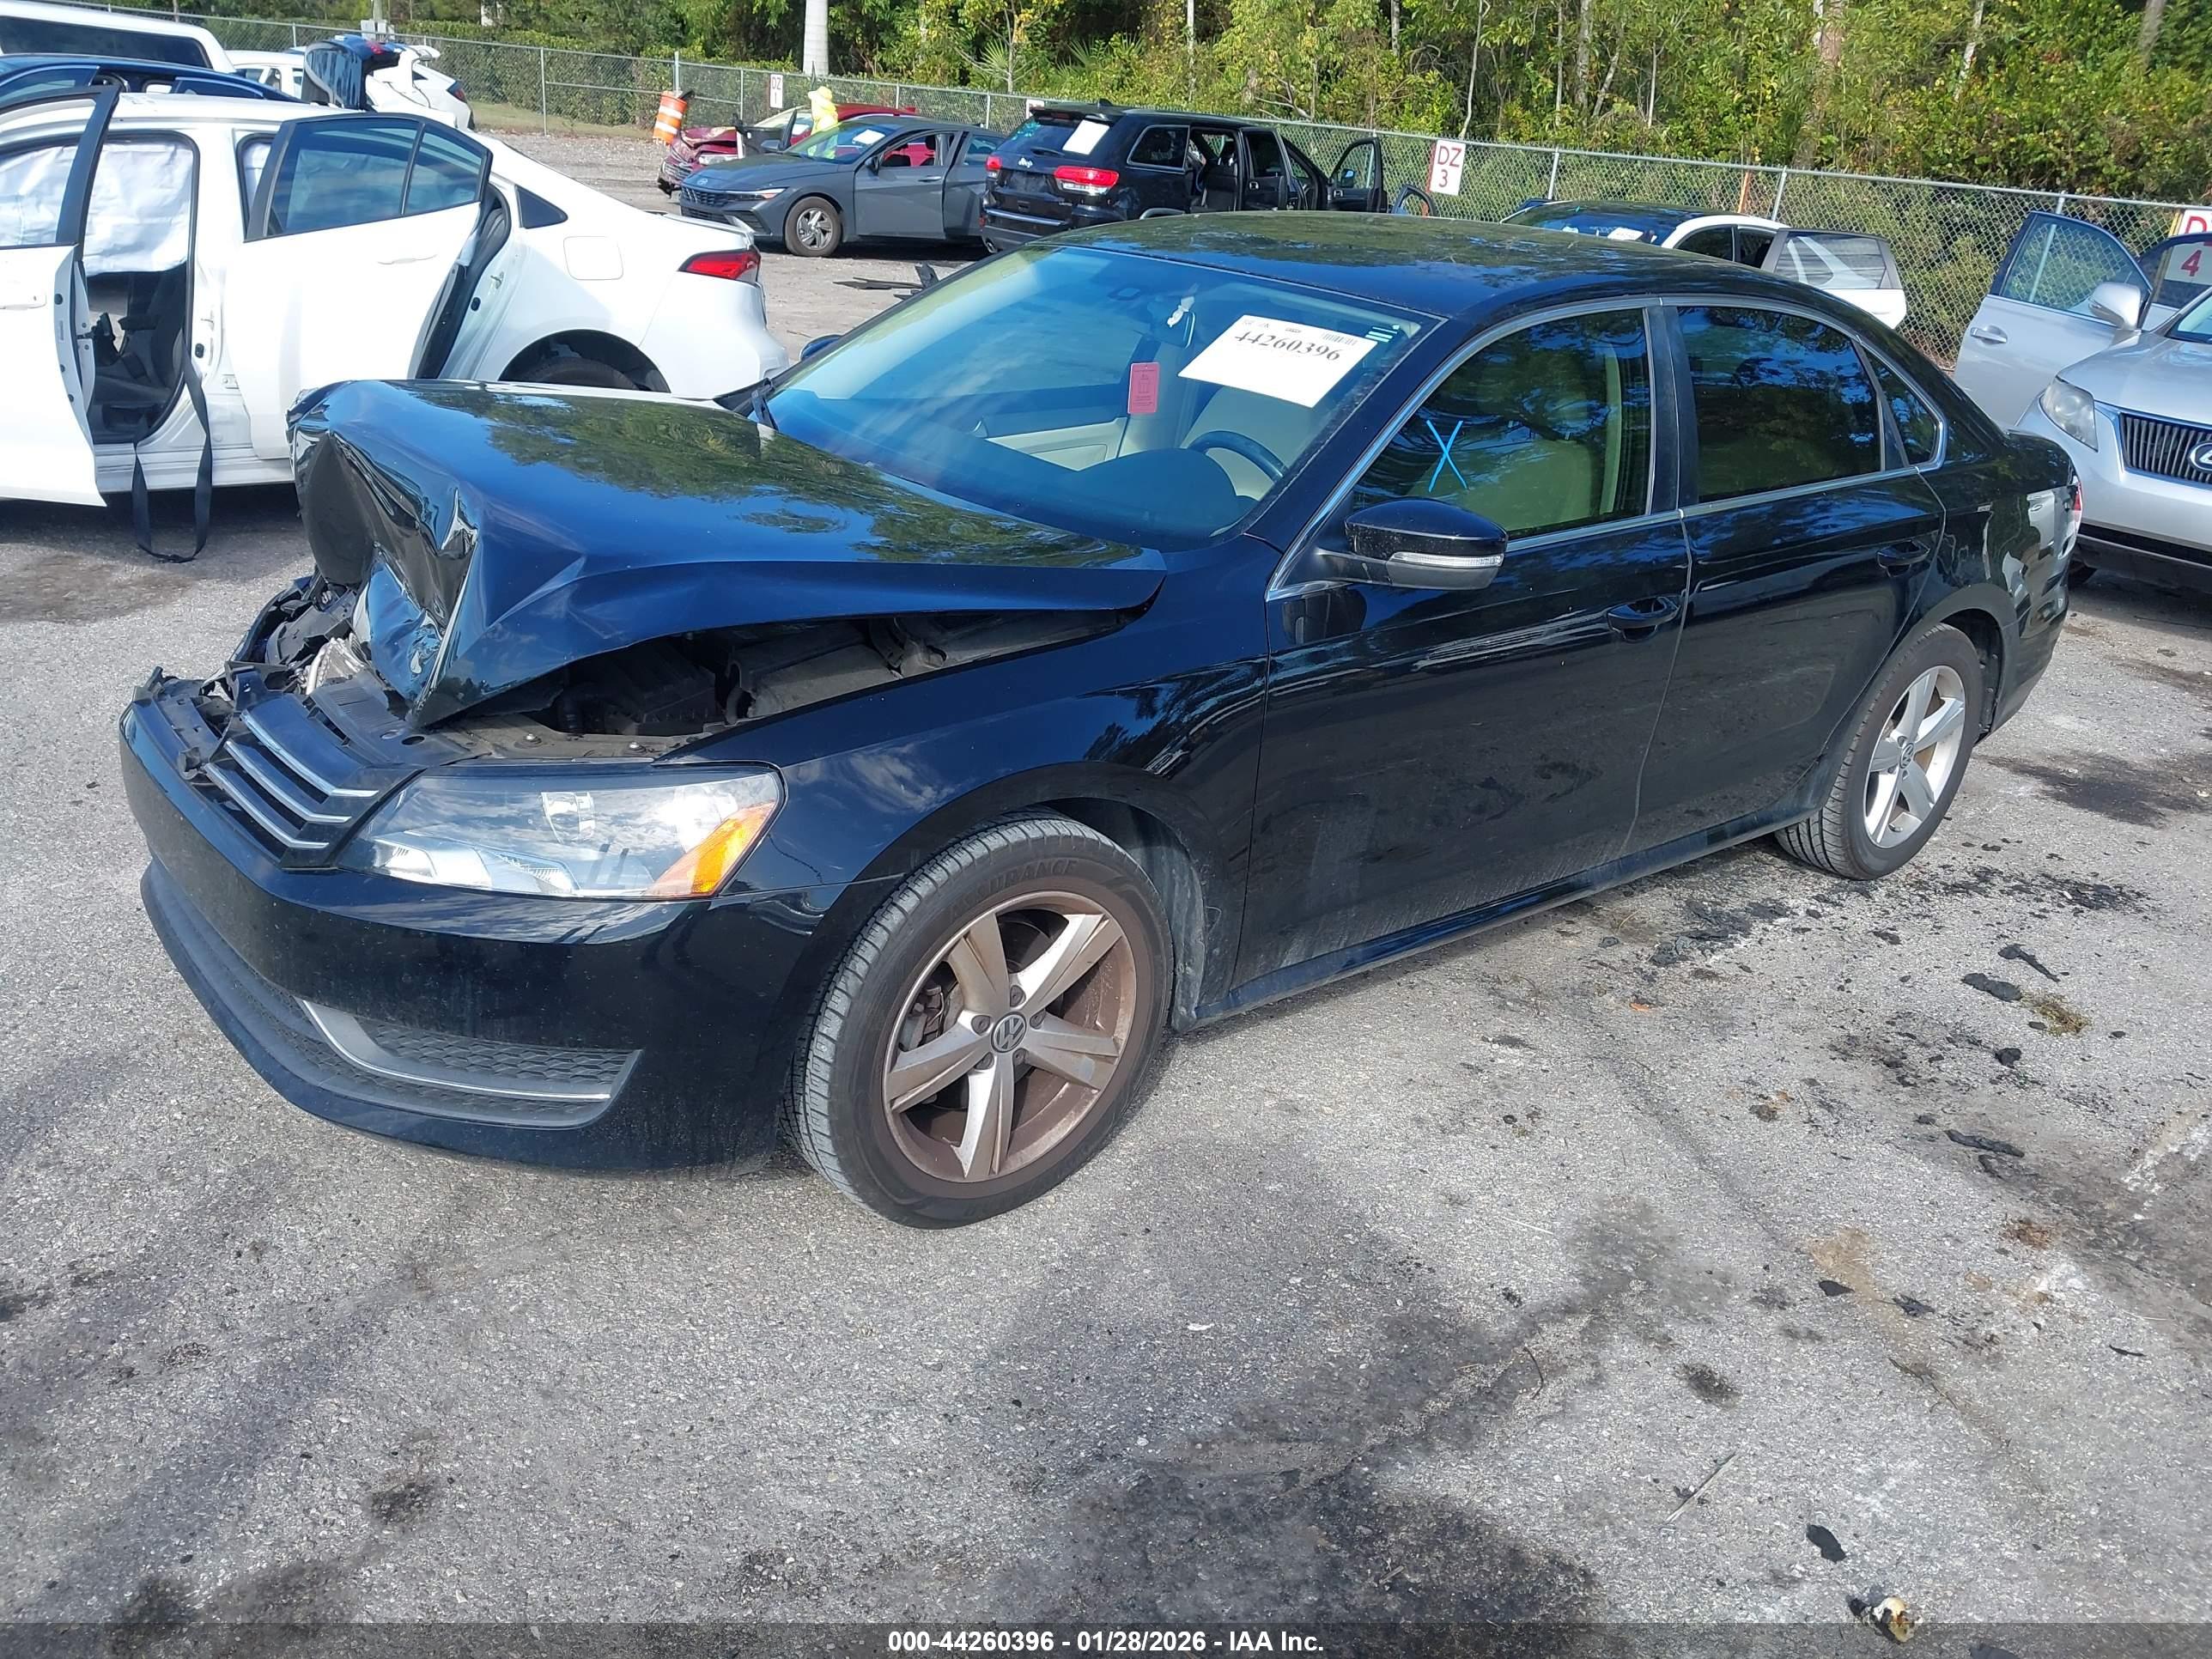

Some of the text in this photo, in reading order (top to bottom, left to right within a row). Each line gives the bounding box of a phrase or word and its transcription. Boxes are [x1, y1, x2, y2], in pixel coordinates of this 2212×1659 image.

[772, 76, 781, 90] DZ
[1437, 145, 1462, 167] DZ
[1438, 168, 1449, 188] 3
[2180, 249, 2203, 277] 4
[1234, 331, 1342, 361] 44260396
